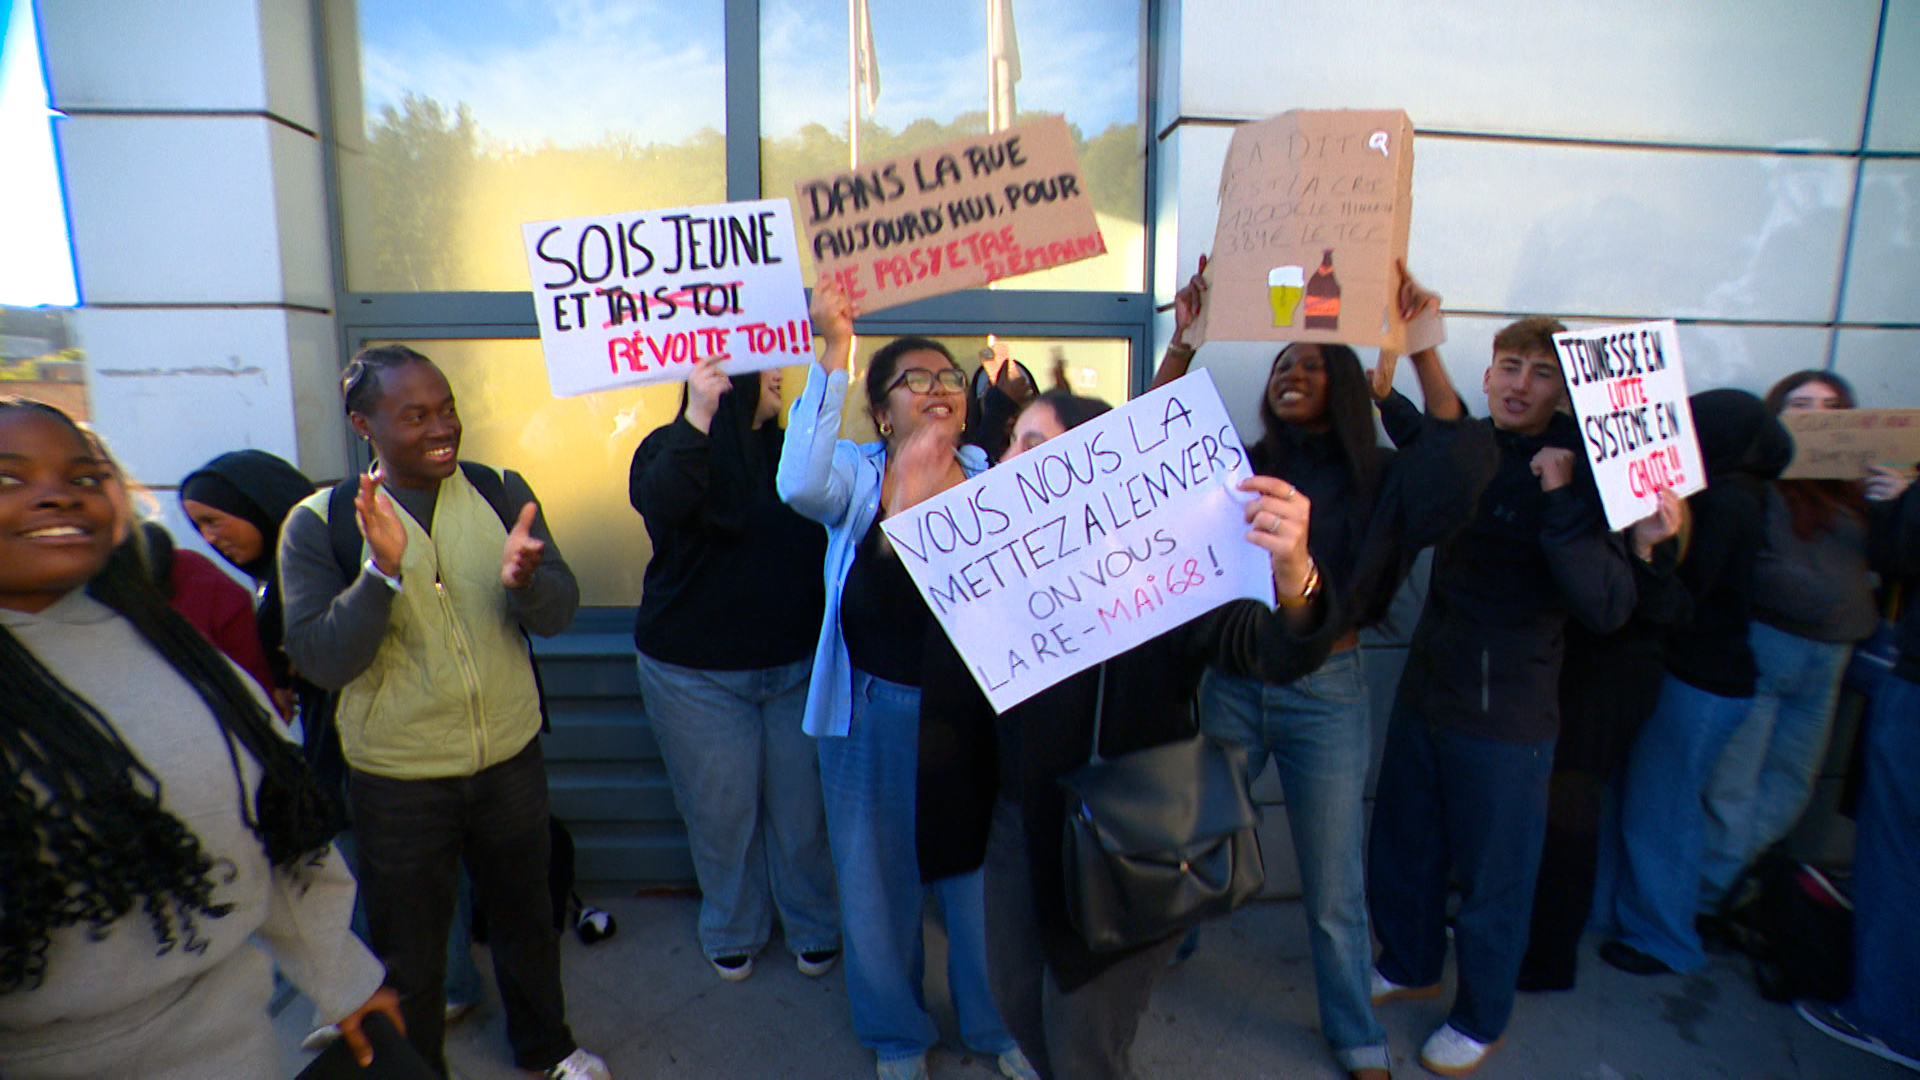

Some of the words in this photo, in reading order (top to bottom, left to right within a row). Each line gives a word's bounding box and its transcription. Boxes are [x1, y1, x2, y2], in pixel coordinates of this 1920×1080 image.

[802, 163, 905, 225] DANS
[913, 153, 961, 192] LA
[963, 136, 1027, 179] RUE
[813, 191, 1004, 262] AUJOURD'HUI,
[1004, 174, 1080, 211] POUR
[946, 225, 1020, 269] ETRE
[536, 220, 654, 289] SOIS
[661, 211, 782, 274] JEUNE
[554, 293, 591, 331] ET
[601, 286, 678, 326] TAIS
[681, 282, 741, 317] TOI
[607, 328, 731, 374] RÉVOLTE
[736, 319, 811, 355] TOI!!
[1559, 331, 1643, 386] JEUNESSE
[1640, 330, 1665, 372] EN
[1607, 377, 1648, 411] LUTTE
[1585, 406, 1653, 463] SYSTEME
[1655, 401, 1680, 440] EN
[887, 485, 1010, 563] VOUS
[1016, 431, 1121, 514] NOUS
[1127, 397, 1192, 455] LA
[928, 516, 1081, 615] METTEZ
[1028, 575, 1083, 620] ON
[1080, 529, 1177, 587] VOUS
[977, 649, 1030, 692] LA
